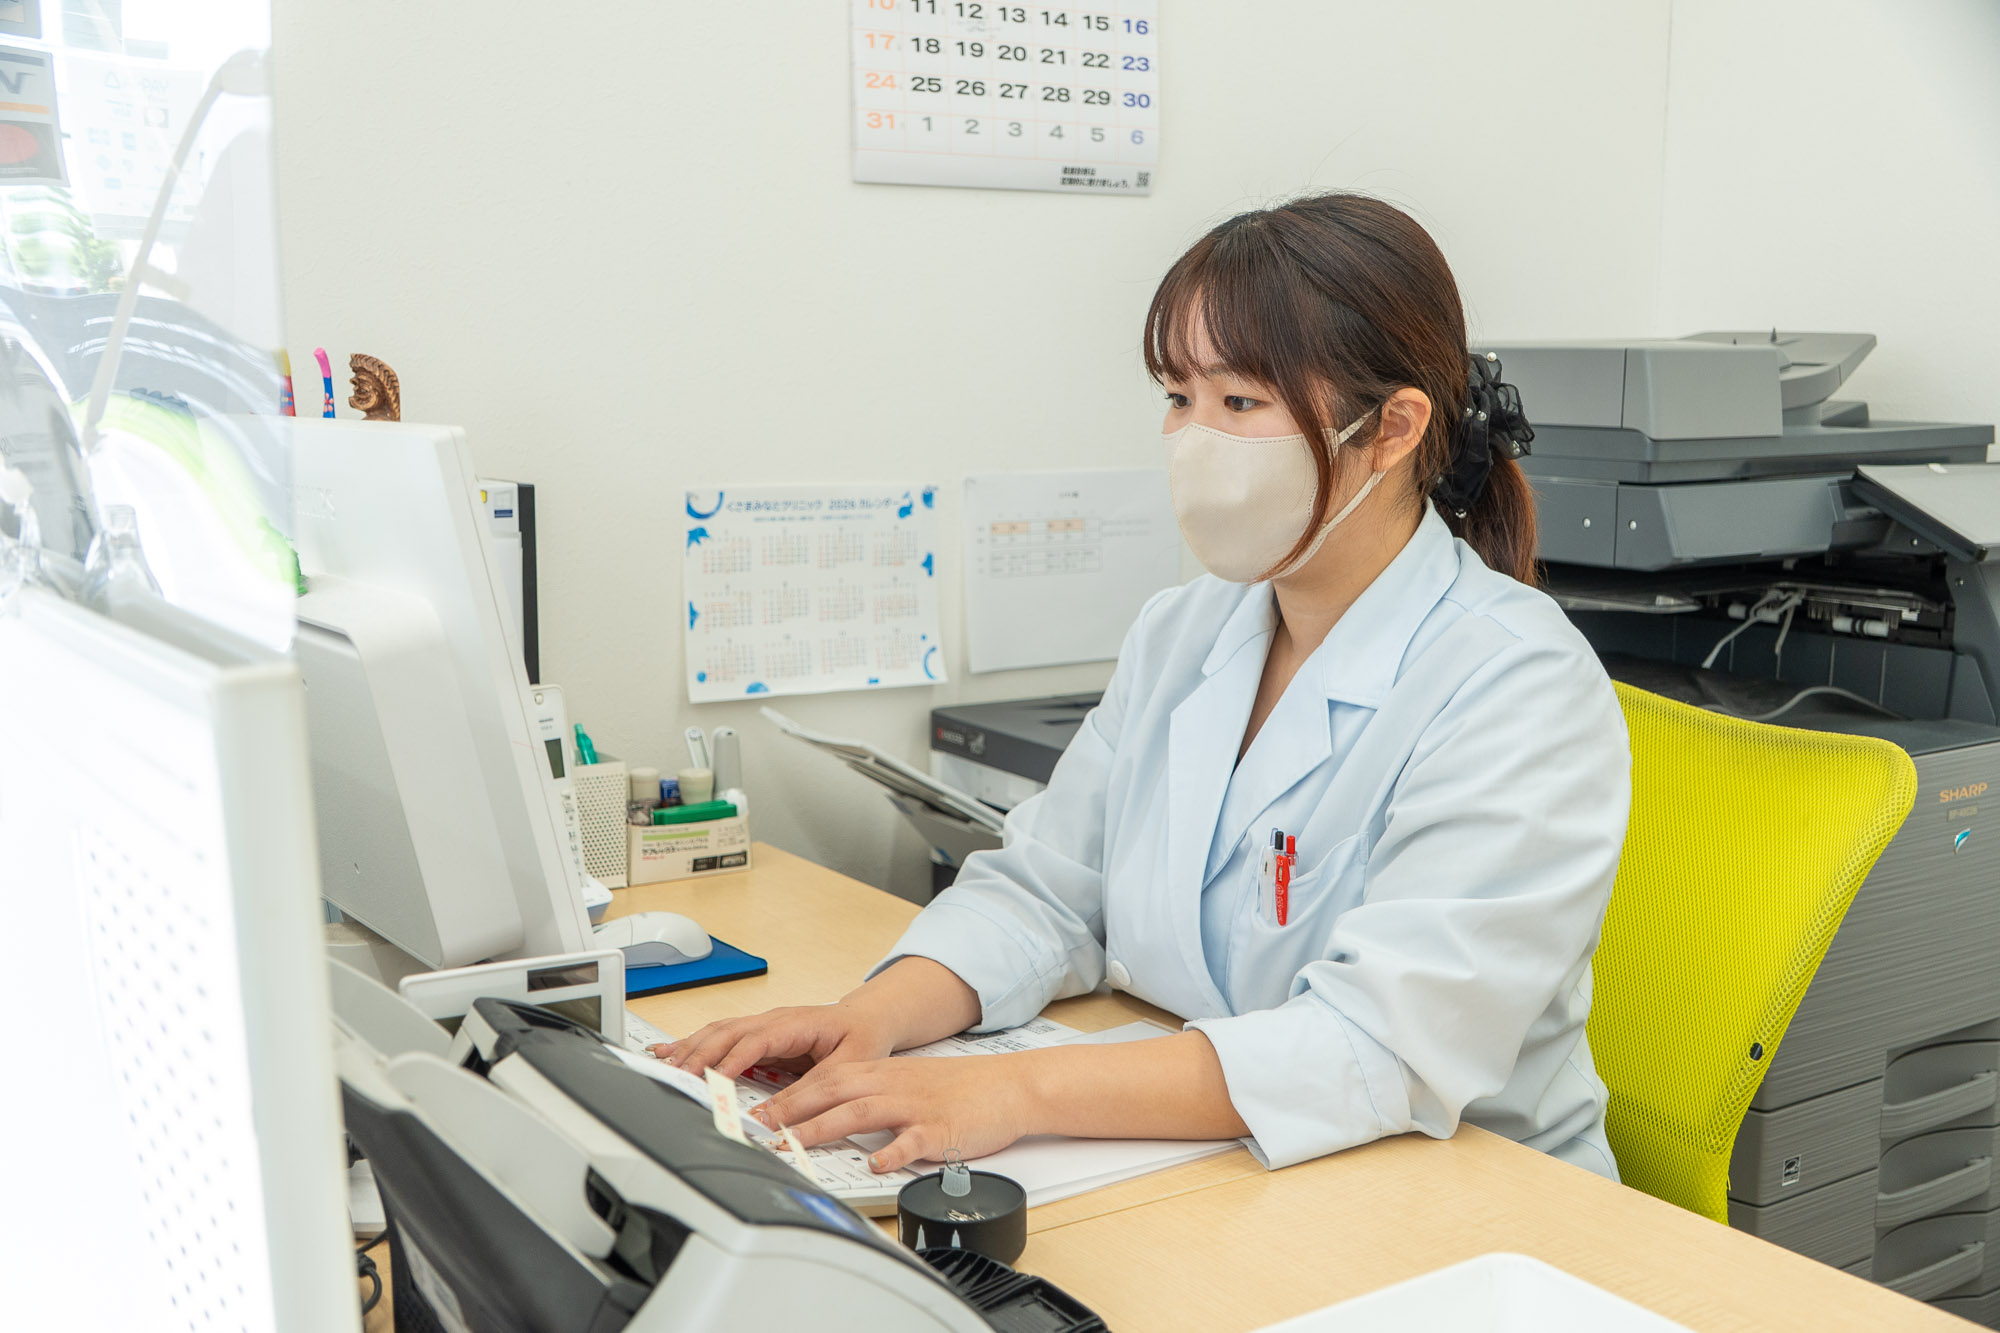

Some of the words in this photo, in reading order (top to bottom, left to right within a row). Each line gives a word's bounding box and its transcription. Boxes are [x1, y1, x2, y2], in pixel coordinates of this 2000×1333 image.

[912, 0, 936, 15] 11
[956, 3, 983, 20] 12
[999, 7, 1026, 24] 13
[1042, 12, 1068, 27] 14
[1084, 16, 1109, 32] 15
[1124, 19, 1149, 35] 16
[866, 33, 896, 51] 17
[912, 38, 941, 54] 18
[957, 42, 984, 58] 19
[999, 45, 1027, 62] 20
[1041, 49, 1065, 65] 21
[1083, 53, 1110, 69] 22
[1123, 56, 1150, 72] 23
[866, 72, 897, 89] 24
[912, 77, 942, 93] 25
[956, 80, 986, 97] 26
[1000, 84, 1029, 100] 27
[1043, 87, 1071, 103] 28
[1084, 90, 1111, 106] 29
[1124, 93, 1151, 109] 30
[868, 112, 895, 129] 31
[922, 117, 932, 132] 1
[965, 119, 980, 135] 2
[1008, 122, 1023, 138] 3
[1050, 125, 1065, 139] 4
[1091, 128, 1105, 143] 5
[1131, 130, 1145, 145] 6
[1940, 782, 1988, 803] SHARP
